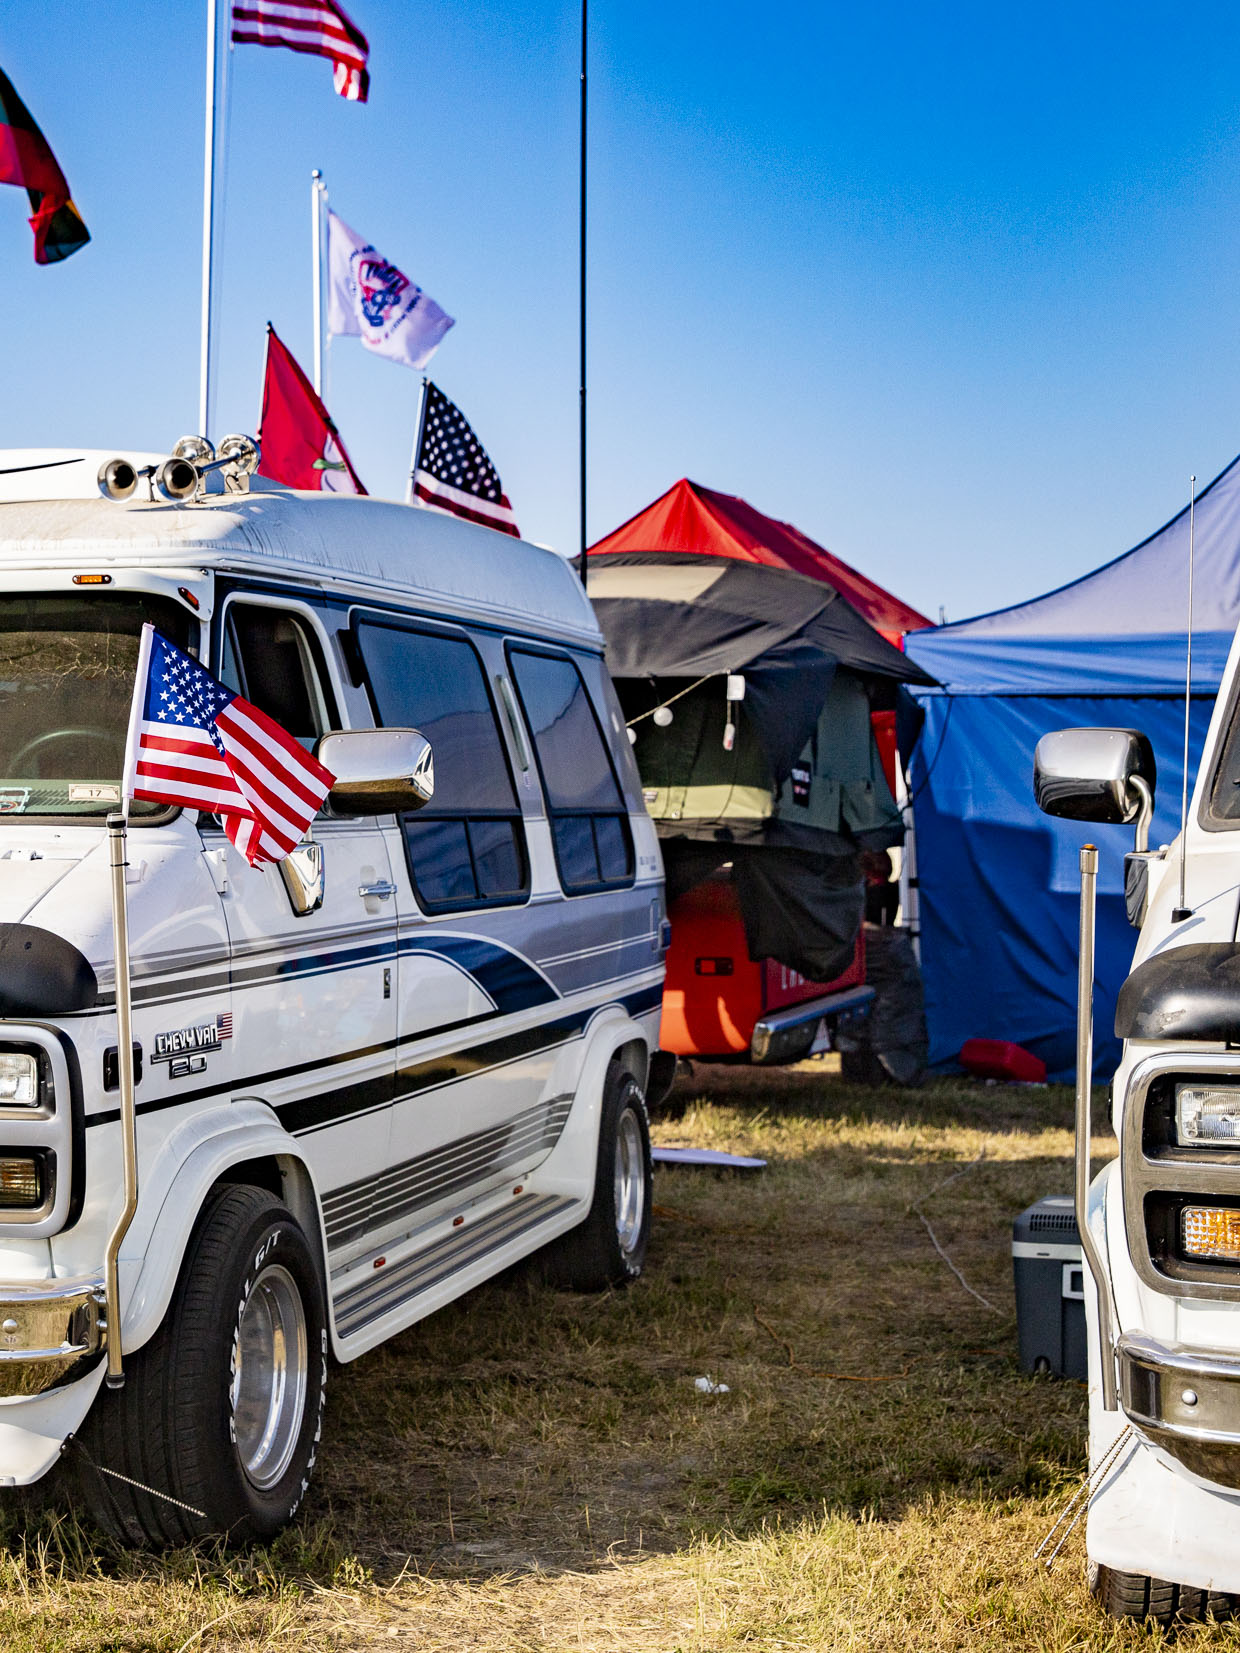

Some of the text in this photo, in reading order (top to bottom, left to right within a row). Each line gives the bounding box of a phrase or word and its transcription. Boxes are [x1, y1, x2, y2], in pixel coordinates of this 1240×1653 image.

[88, 789, 102, 797] 17
[156, 1023, 219, 1053] CHEVY VAN
